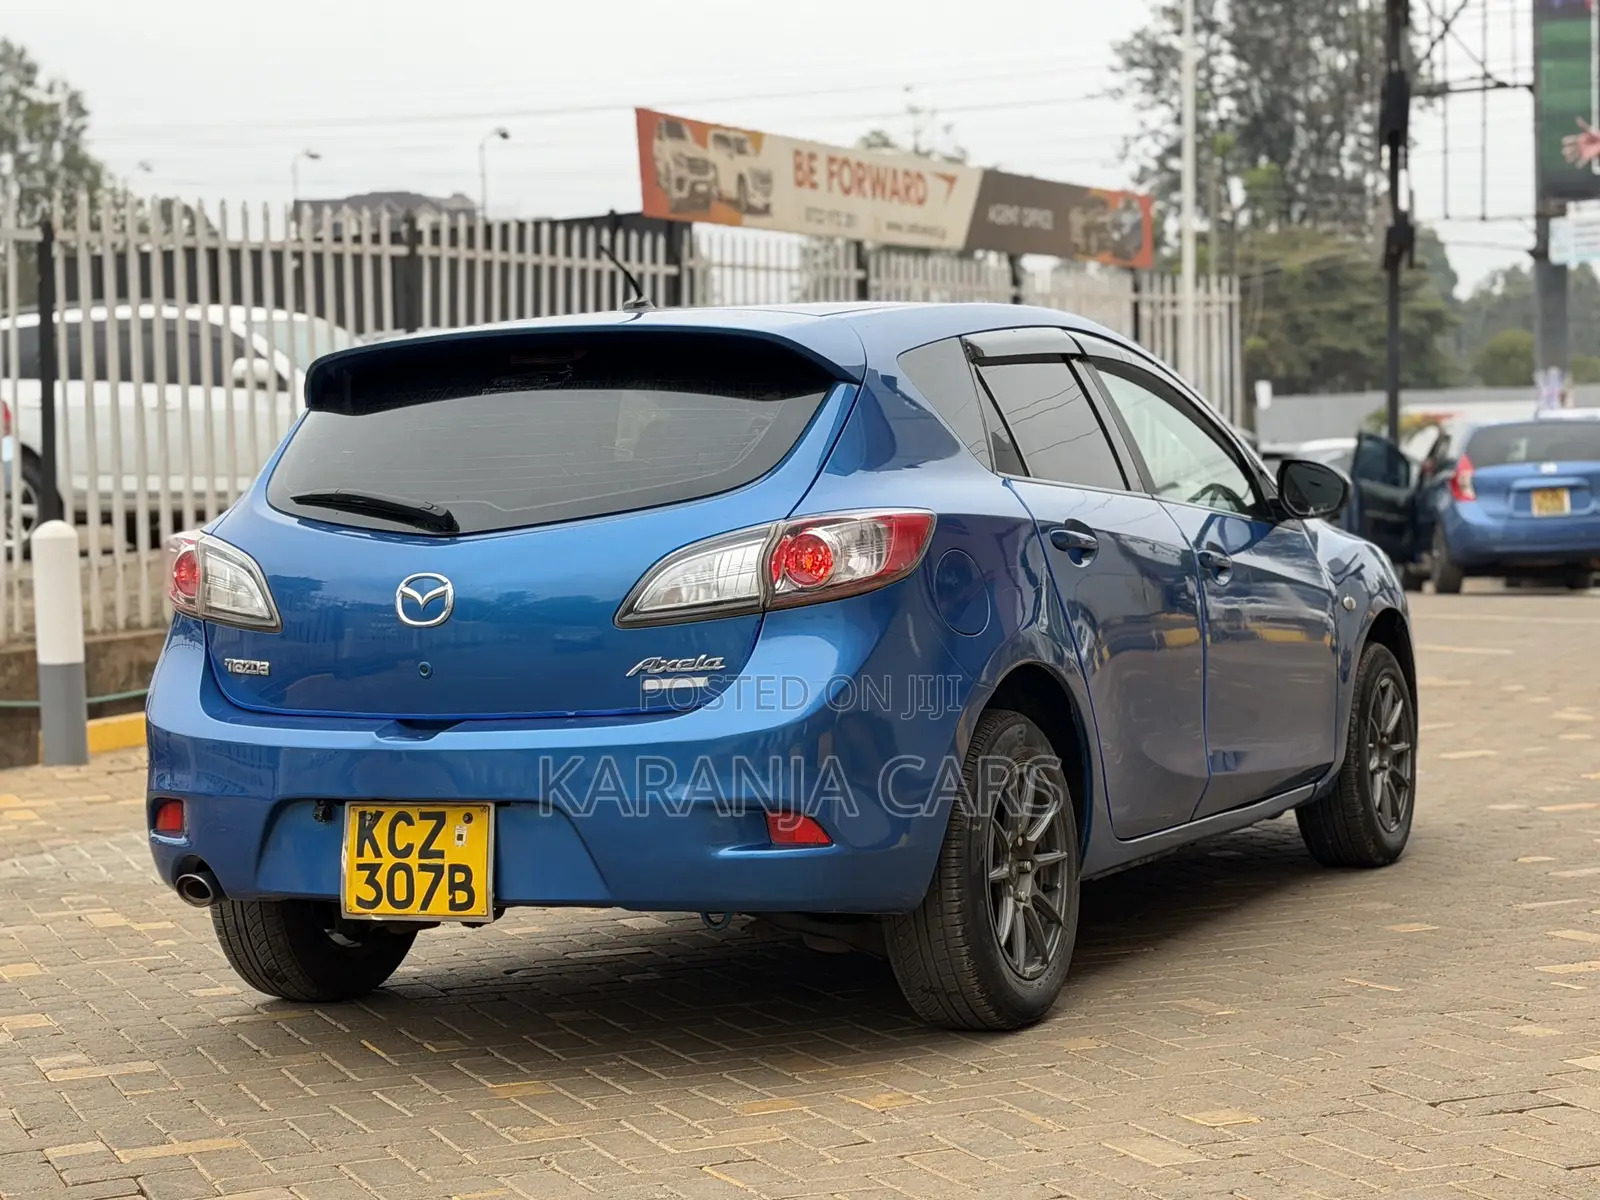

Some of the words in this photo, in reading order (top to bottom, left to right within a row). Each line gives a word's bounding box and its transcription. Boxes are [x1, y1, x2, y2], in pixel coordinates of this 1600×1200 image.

[793, 150, 819, 190] BE
[827, 154, 928, 206] FORWARD
[625, 654, 726, 677] Axela
[356, 810, 447, 859] KCZ
[355, 862, 476, 912] 307B
